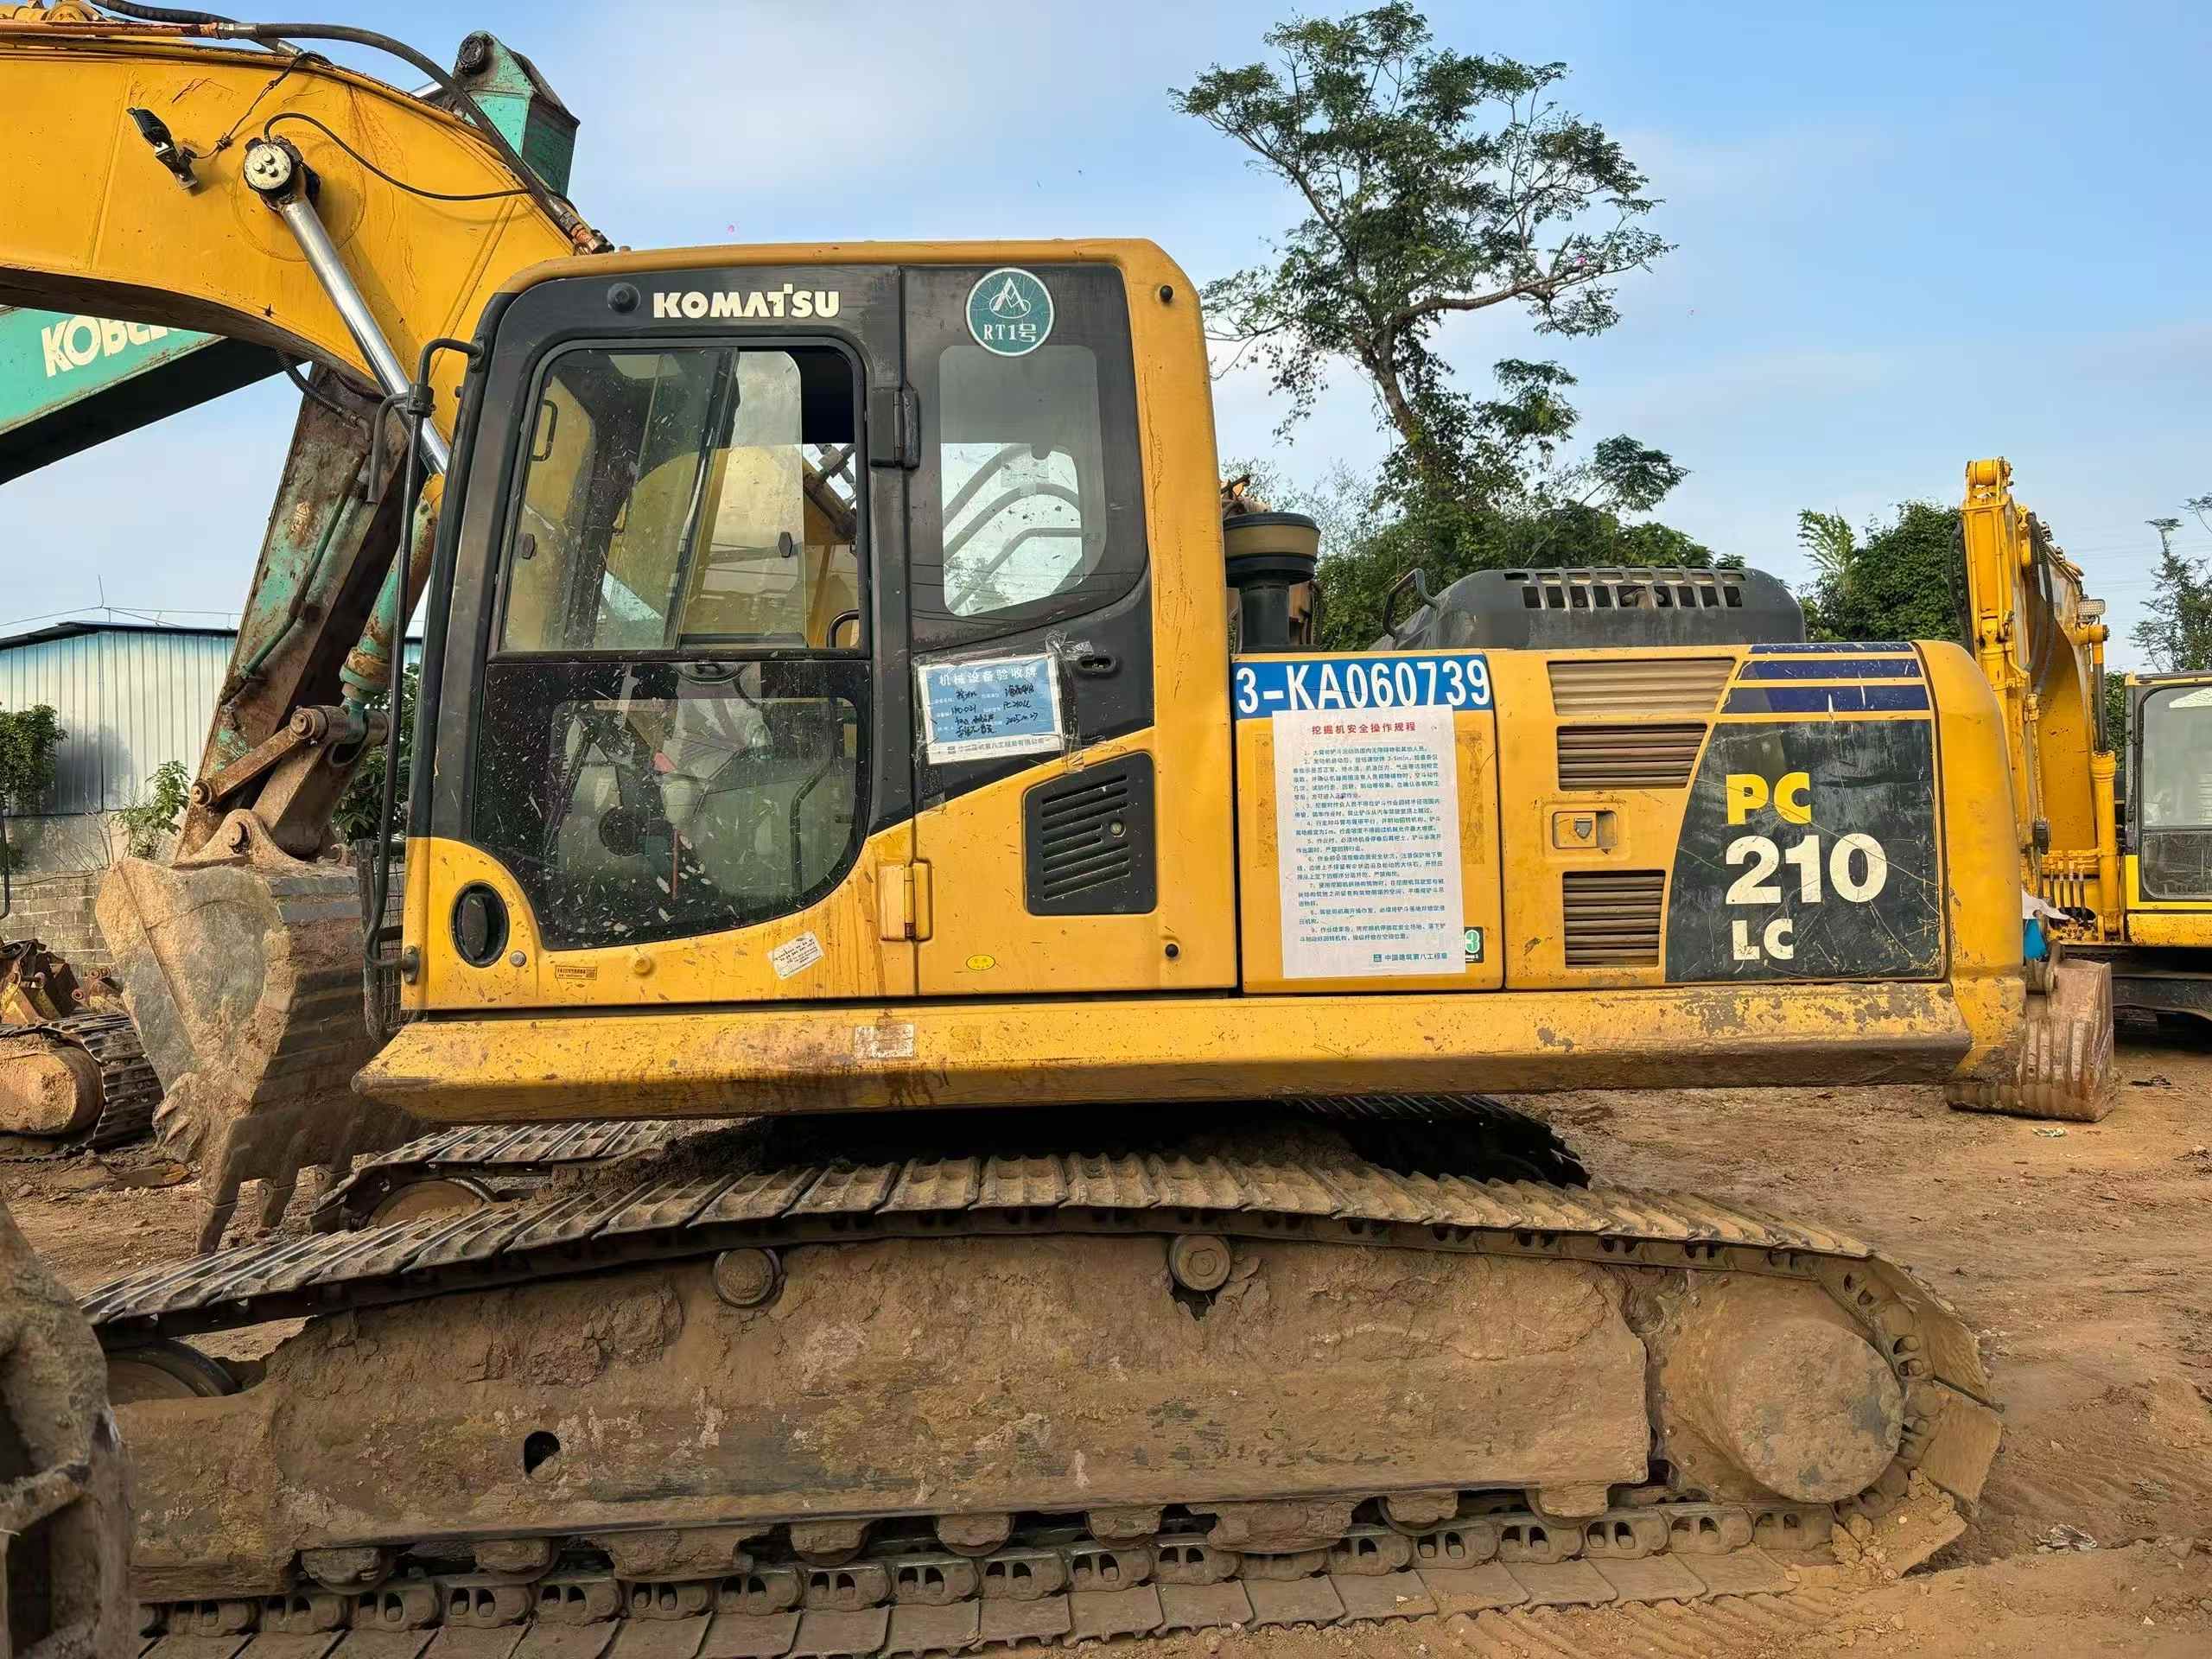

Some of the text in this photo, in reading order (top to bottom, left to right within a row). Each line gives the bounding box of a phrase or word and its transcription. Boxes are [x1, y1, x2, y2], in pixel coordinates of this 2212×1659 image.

[653, 283, 840, 319] KOMATSU
[939, 666, 1037, 686] 机械设备验收牌
[1236, 658, 1491, 714] 3-KA060739
[1312, 721, 1416, 735] 挖掘机安全操作规程
[1726, 772, 1812, 825] PC
[1726, 834, 1887, 905] 210
[1732, 919, 1794, 961] LC
